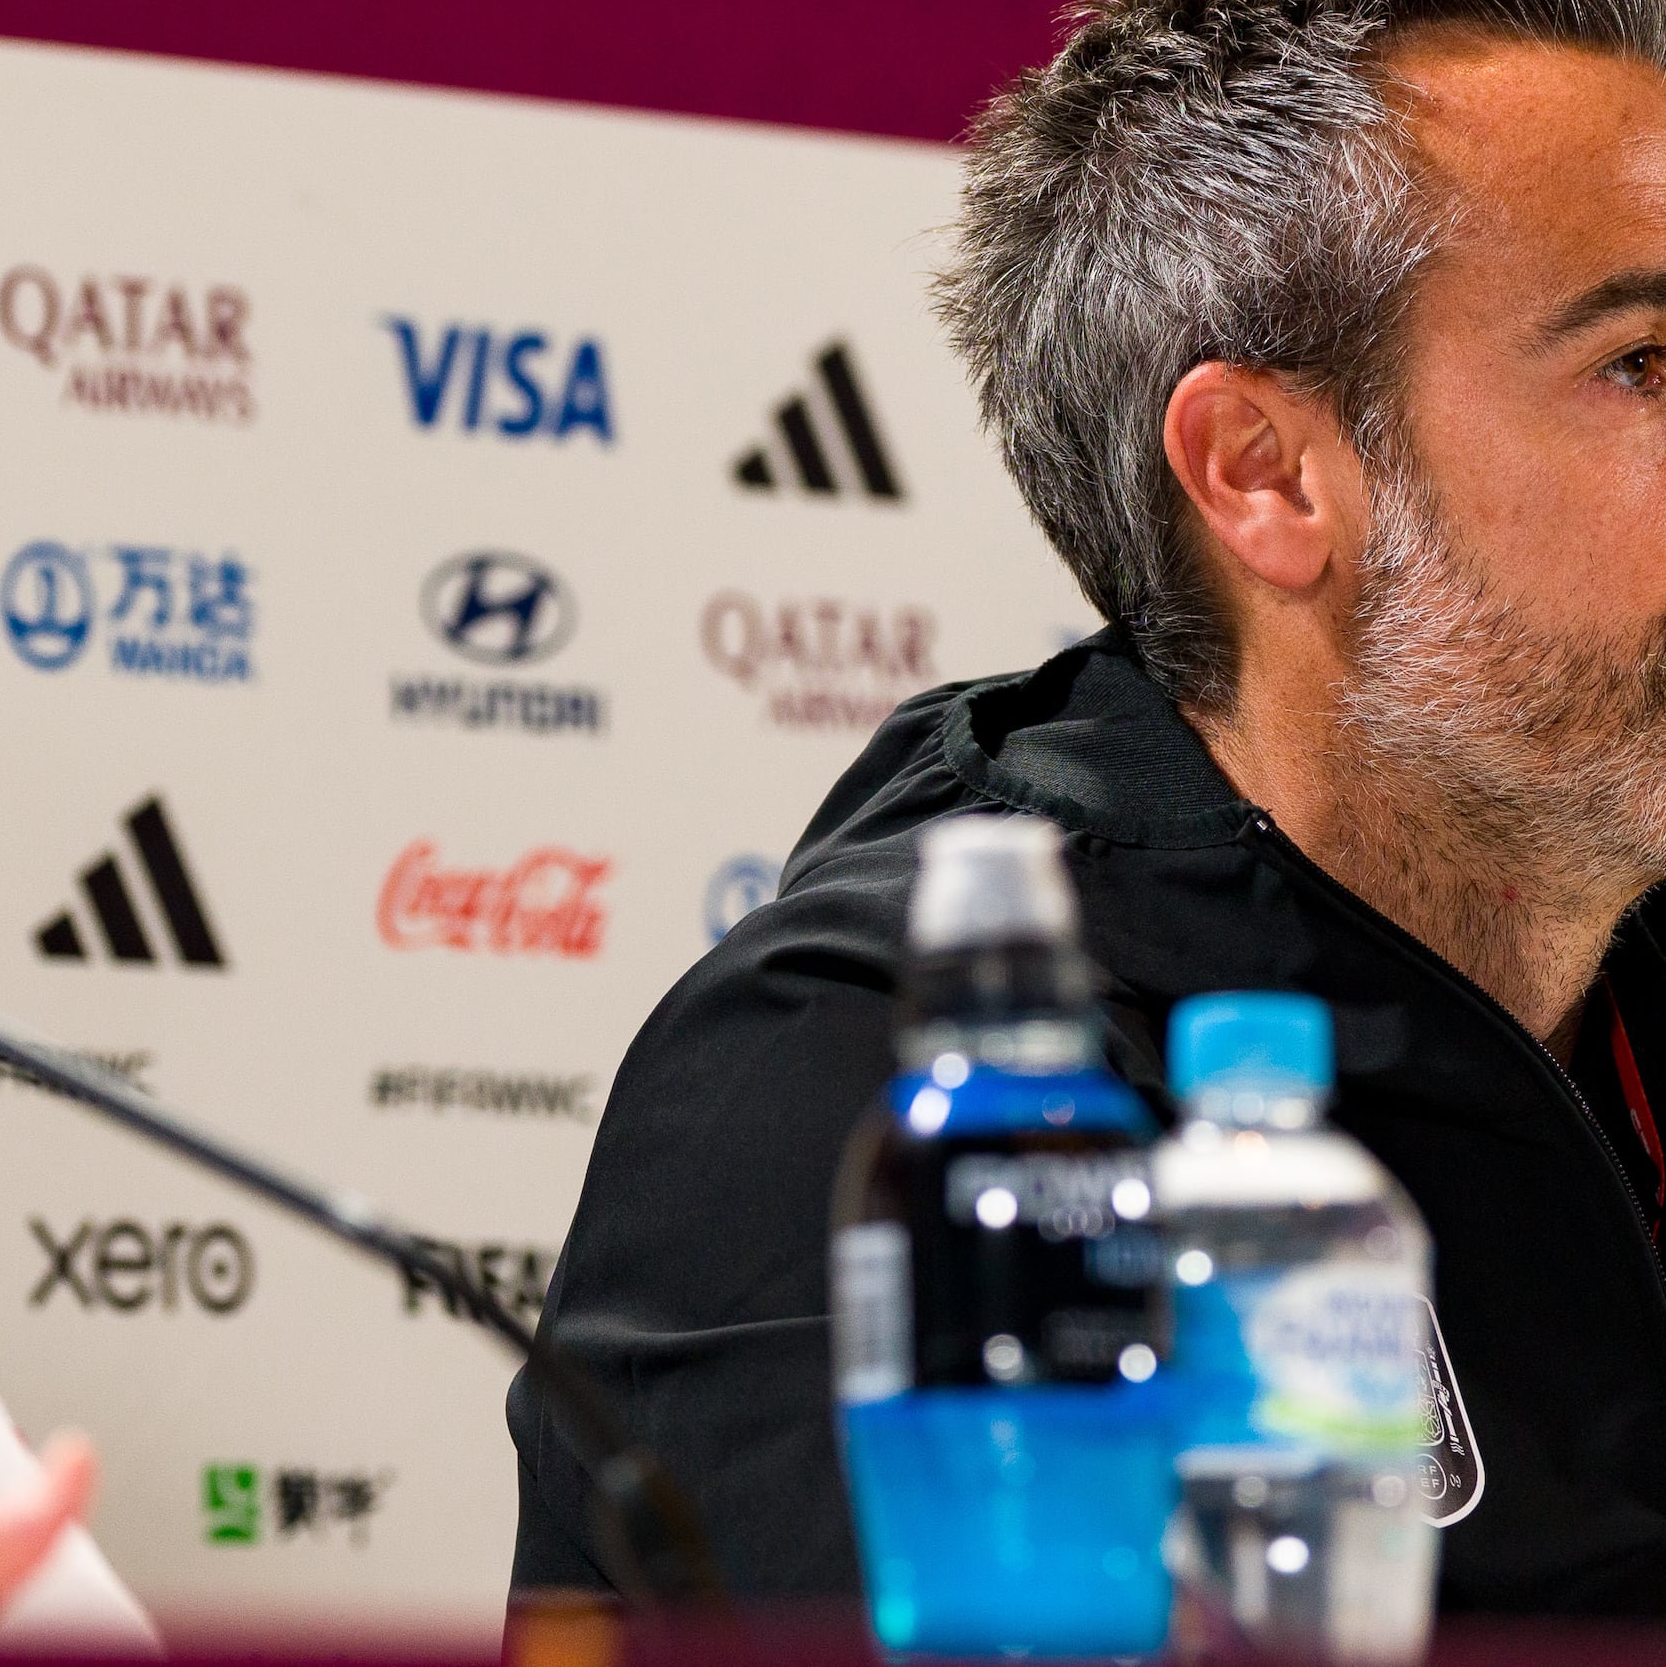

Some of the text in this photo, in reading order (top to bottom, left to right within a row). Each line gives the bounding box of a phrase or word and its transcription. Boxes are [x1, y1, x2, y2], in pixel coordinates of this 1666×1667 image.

[385, 313, 615, 449] VISA
[699, 589, 939, 689] QATAR
[27, 1213, 257, 1319] xero
